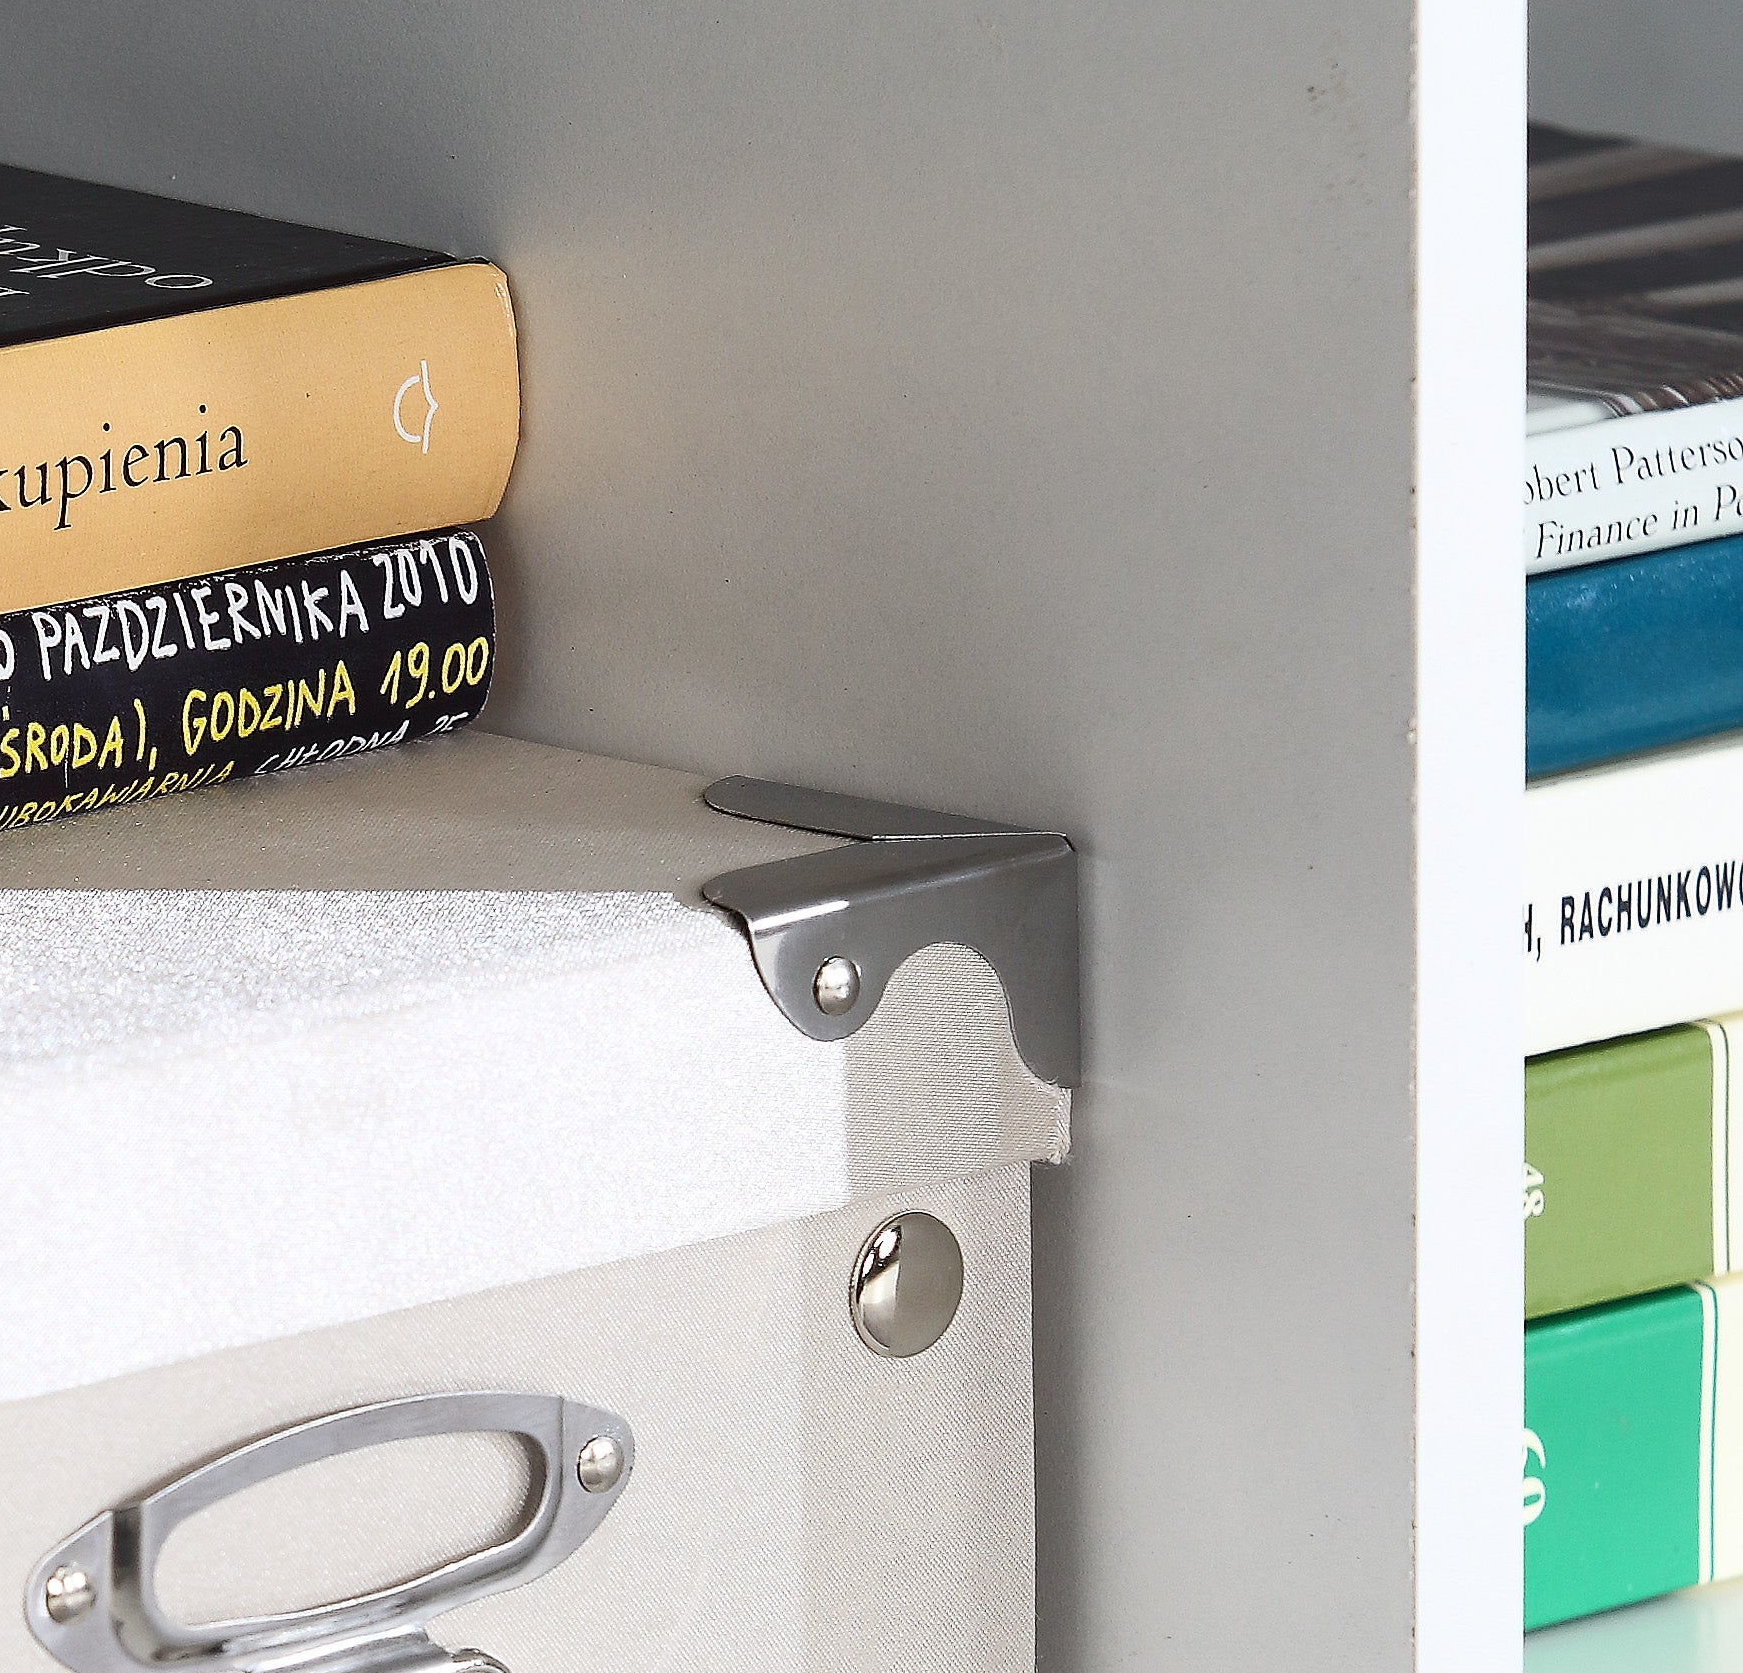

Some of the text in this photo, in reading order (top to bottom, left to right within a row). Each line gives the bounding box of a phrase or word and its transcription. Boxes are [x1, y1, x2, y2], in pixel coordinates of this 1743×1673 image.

[1535, 519, 1658, 559] Finance
[1672, 500, 1698, 531] in
[373, 536, 478, 620] 2010
[182, 660, 356, 757] GODZINA
[381, 636, 490, 707] 19.00
